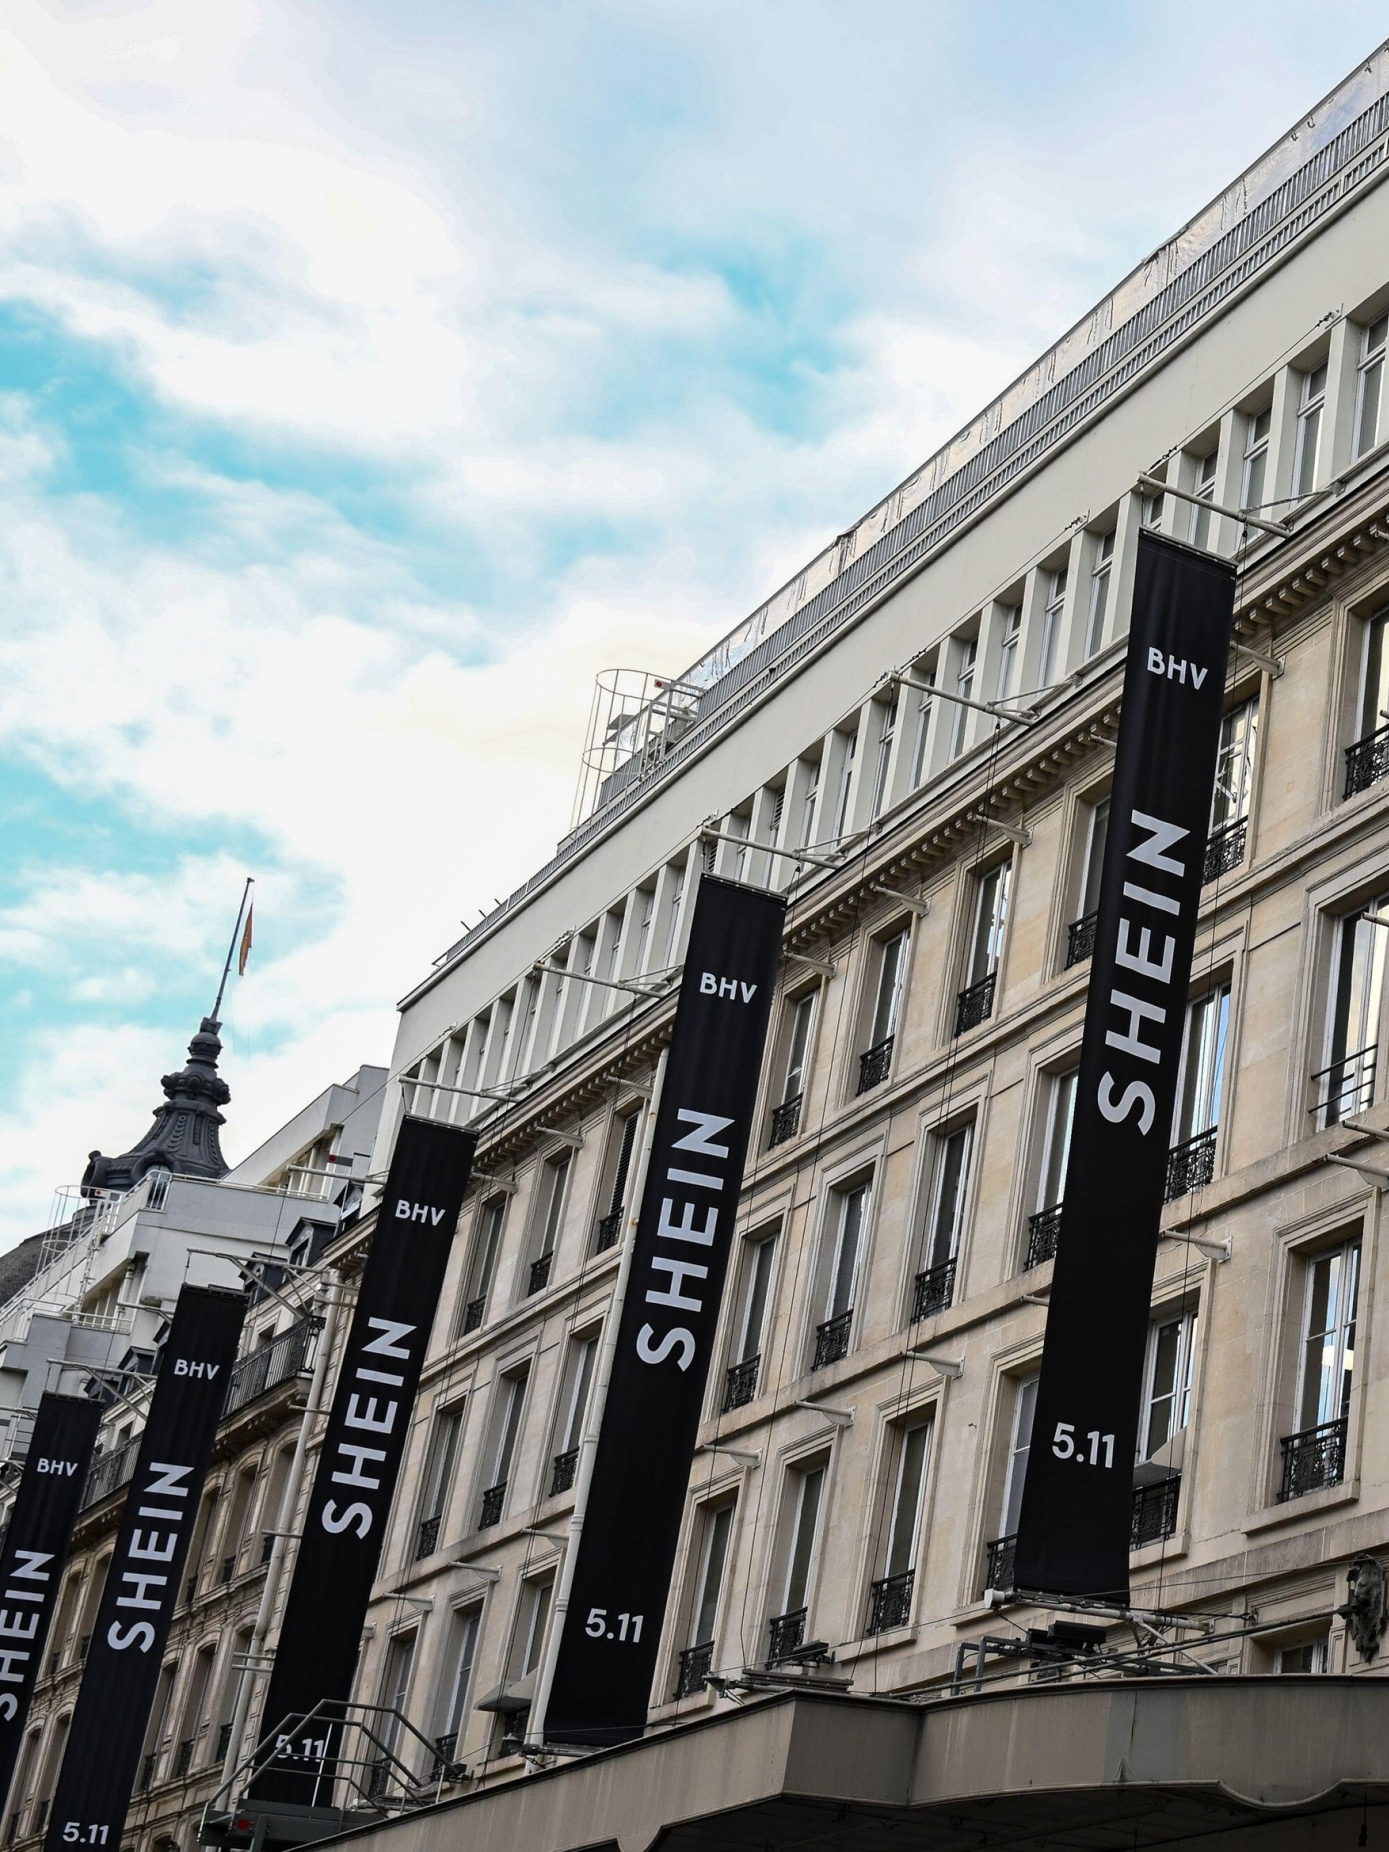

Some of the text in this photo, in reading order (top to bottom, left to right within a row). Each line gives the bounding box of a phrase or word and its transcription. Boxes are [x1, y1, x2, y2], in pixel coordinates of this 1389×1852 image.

[1147, 646, 1208, 690] BHV
[699, 972, 758, 1004] BHV
[1097, 809, 1192, 1137] SHEIN
[395, 1199, 446, 1226] BHV
[636, 1108, 736, 1373] SHEIN
[173, 1359, 220, 1380] BHV
[321, 1316, 417, 1540] SHEIN
[1052, 1422, 1115, 1469] 5.11
[36, 1457, 78, 1477] BHV
[107, 1462, 195, 1653] SHEIN
[585, 1608, 644, 1643] 5.11
[275, 1734, 325, 1763] 5.11
[62, 1821, 109, 1845] 5.11
